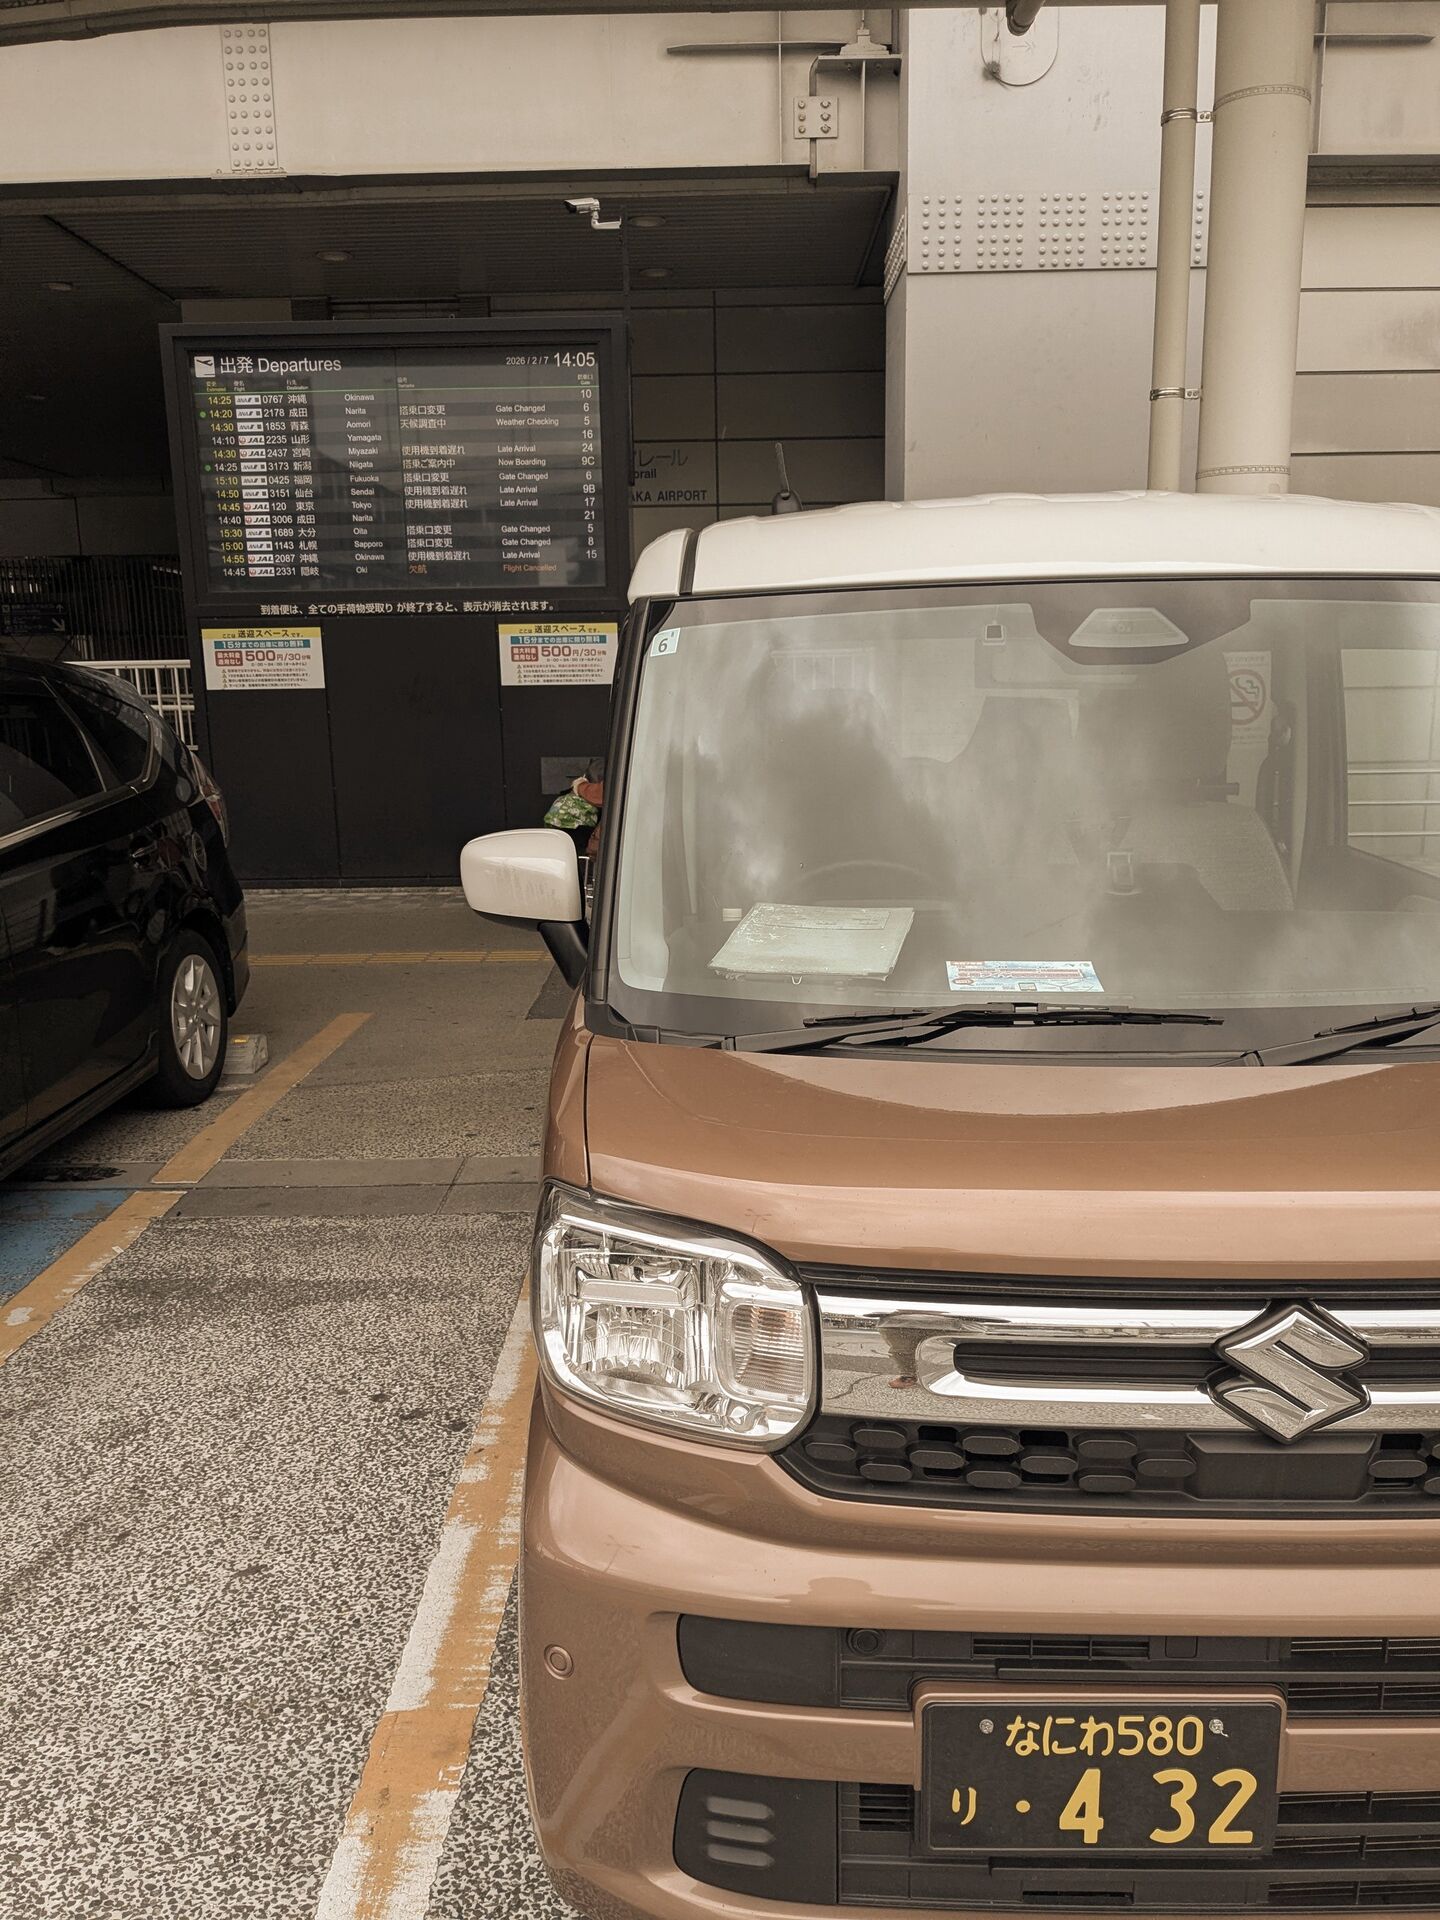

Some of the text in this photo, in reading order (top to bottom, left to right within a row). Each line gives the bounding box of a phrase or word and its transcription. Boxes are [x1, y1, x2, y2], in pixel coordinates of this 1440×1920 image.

[220, 356, 342, 376] 出発 Departures
[554, 352, 595, 367] 14:05
[208, 396, 232, 405] 14:25
[262, 395, 283, 404] 0767
[581, 390, 592, 398] 10
[209, 410, 233, 418] 14:20
[264, 408, 285, 417] 2178
[289, 408, 308, 417] 成田
[514, 404, 546, 413] Changed
[584, 403, 589, 412] 6
[210, 423, 234, 431] 14:30
[266, 422, 286, 431] 1853
[496, 418, 525, 426] Weather
[527, 417, 559, 426] Checking
[584, 416, 590, 425] 5
[212, 436, 236, 445] 14:10
[266, 436, 287, 444] 2235
[292, 435, 310, 444] 山形
[348, 434, 382, 443] Yamagata
[582, 430, 593, 439] 16
[213, 450, 237, 458] 14:30
[267, 449, 288, 457] 2437
[348, 448, 378, 456] Miyazaki
[582, 444, 593, 452] 24
[633, 449, 688, 466] レール
[214, 464, 238, 472] 14:25
[268, 462, 289, 470] 3173
[349, 461, 373, 470] Niigata
[516, 458, 546, 467] Boarding
[582, 456, 595, 465] 9C
[269, 476, 290, 484] 0425
[518, 472, 548, 481] Changed
[586, 472, 592, 480] 6
[216, 490, 239, 499] 14:50
[270, 489, 290, 498] 3151
[295, 489, 314, 498] 仙台
[350, 488, 375, 496] Sendai
[500, 486, 514, 494] Late
[583, 485, 596, 493] 9B
[657, 490, 707, 502] AIRPORT
[217, 504, 241, 512] 14:45
[271, 502, 287, 511] 120
[352, 502, 372, 510] Tokyo
[584, 498, 595, 506] 17
[218, 516, 242, 525] 14:40
[272, 516, 293, 524] 3006
[297, 515, 316, 524] 成田
[584, 511, 595, 519] 21
[220, 530, 243, 538] 15:30
[273, 528, 294, 537] 1689
[298, 528, 316, 537] 大分
[520, 525, 551, 533] Changed
[588, 524, 593, 533] 5
[221, 543, 244, 551] 15:00
[274, 542, 294, 550] 1143
[354, 540, 383, 549] Sapporo
[520, 538, 551, 547] Changed
[588, 537, 594, 546] 8
[275, 554, 295, 562] 2087
[586, 550, 597, 559] 15
[223, 568, 246, 576] 14:45
[504, 564, 522, 572] Flight
[658, 638, 668, 653] 6
